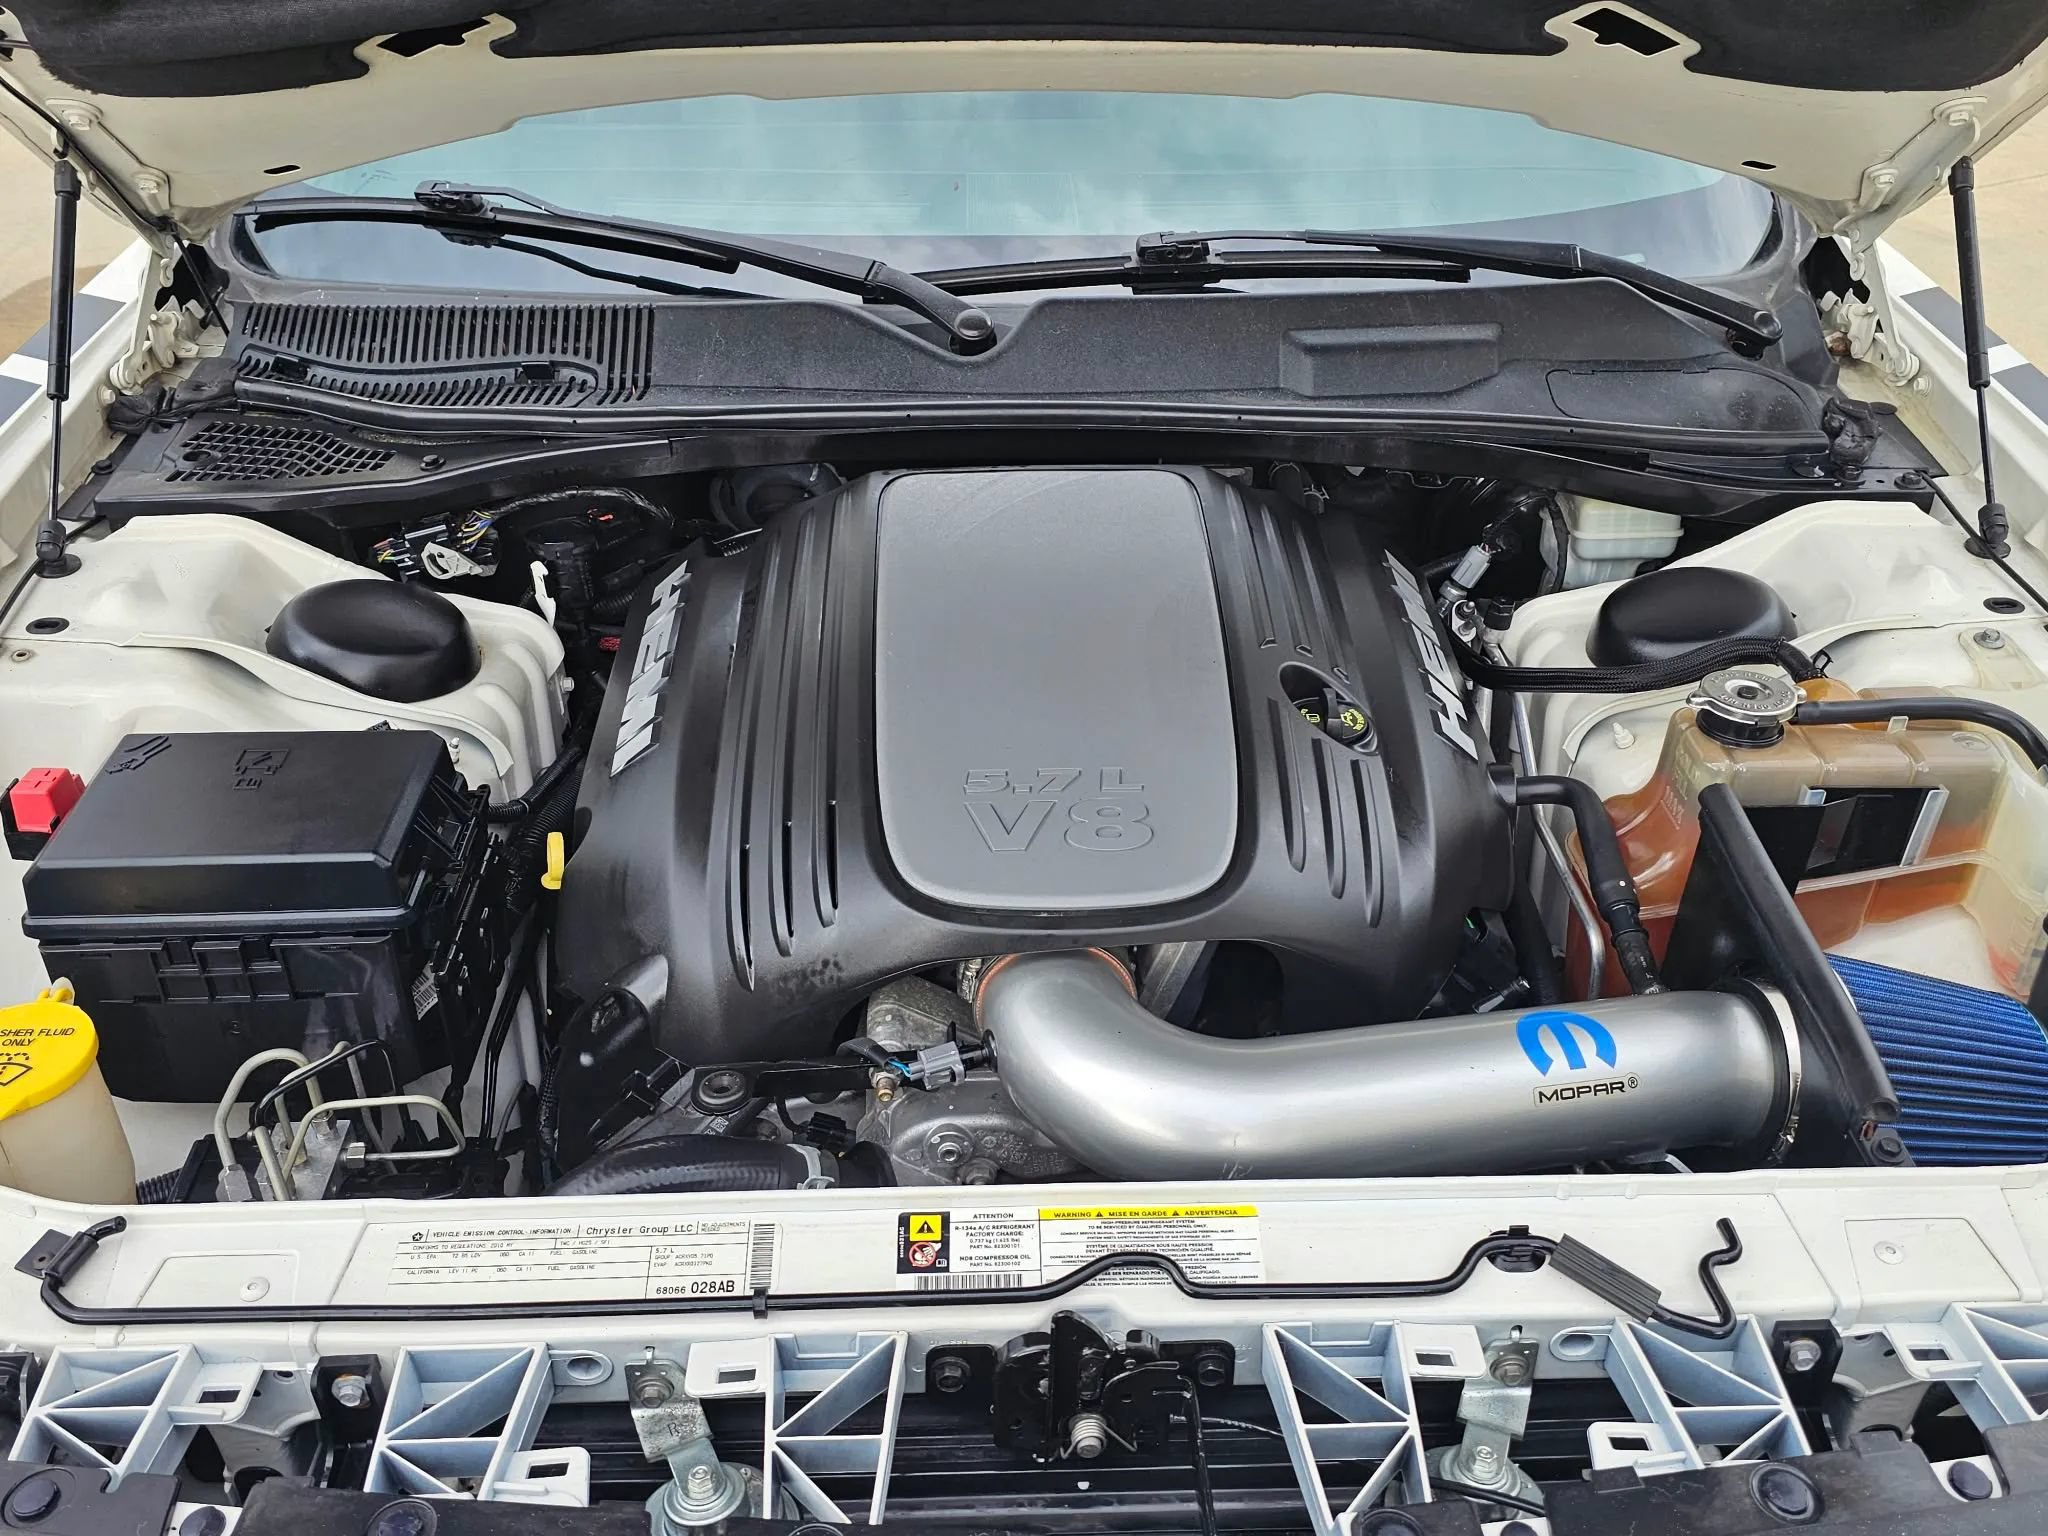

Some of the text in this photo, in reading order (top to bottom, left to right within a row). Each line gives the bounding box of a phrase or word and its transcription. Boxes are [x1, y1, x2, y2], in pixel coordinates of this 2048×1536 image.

[1382, 549, 1478, 761] HEMI
[610, 560, 692, 777] HEMI
[963, 796, 1154, 853] V8
[38, 1027, 75, 1036] FLUID
[2, 1038, 36, 1046] ONLY
[586, 1224, 693, 1238] Chrysler Group LLC
[655, 1280, 735, 1295] 68066 028AB
